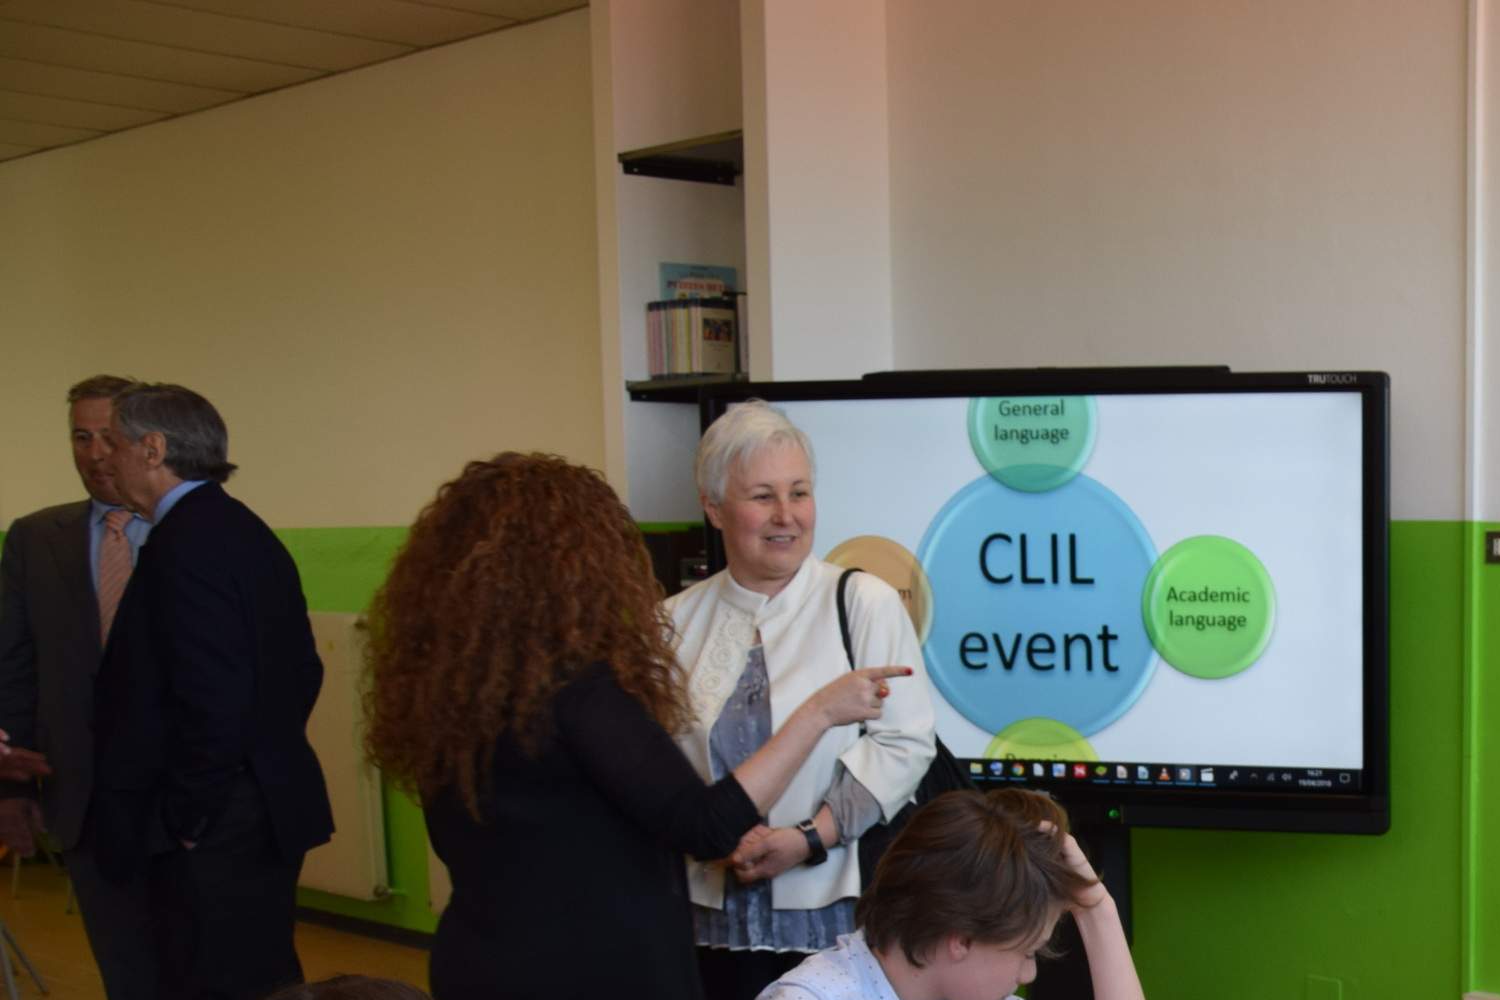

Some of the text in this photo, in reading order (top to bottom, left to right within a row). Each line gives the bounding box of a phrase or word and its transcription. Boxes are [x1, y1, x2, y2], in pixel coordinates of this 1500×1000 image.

[1307, 373, 1358, 384] TRUTOUCH
[998, 399, 1065, 416] General
[994, 424, 1070, 444] language
[979, 532, 1095, 585] CLIL
[1166, 585, 1251, 603] Academic
[1169, 610, 1247, 631] language
[959, 624, 1120, 672] event
